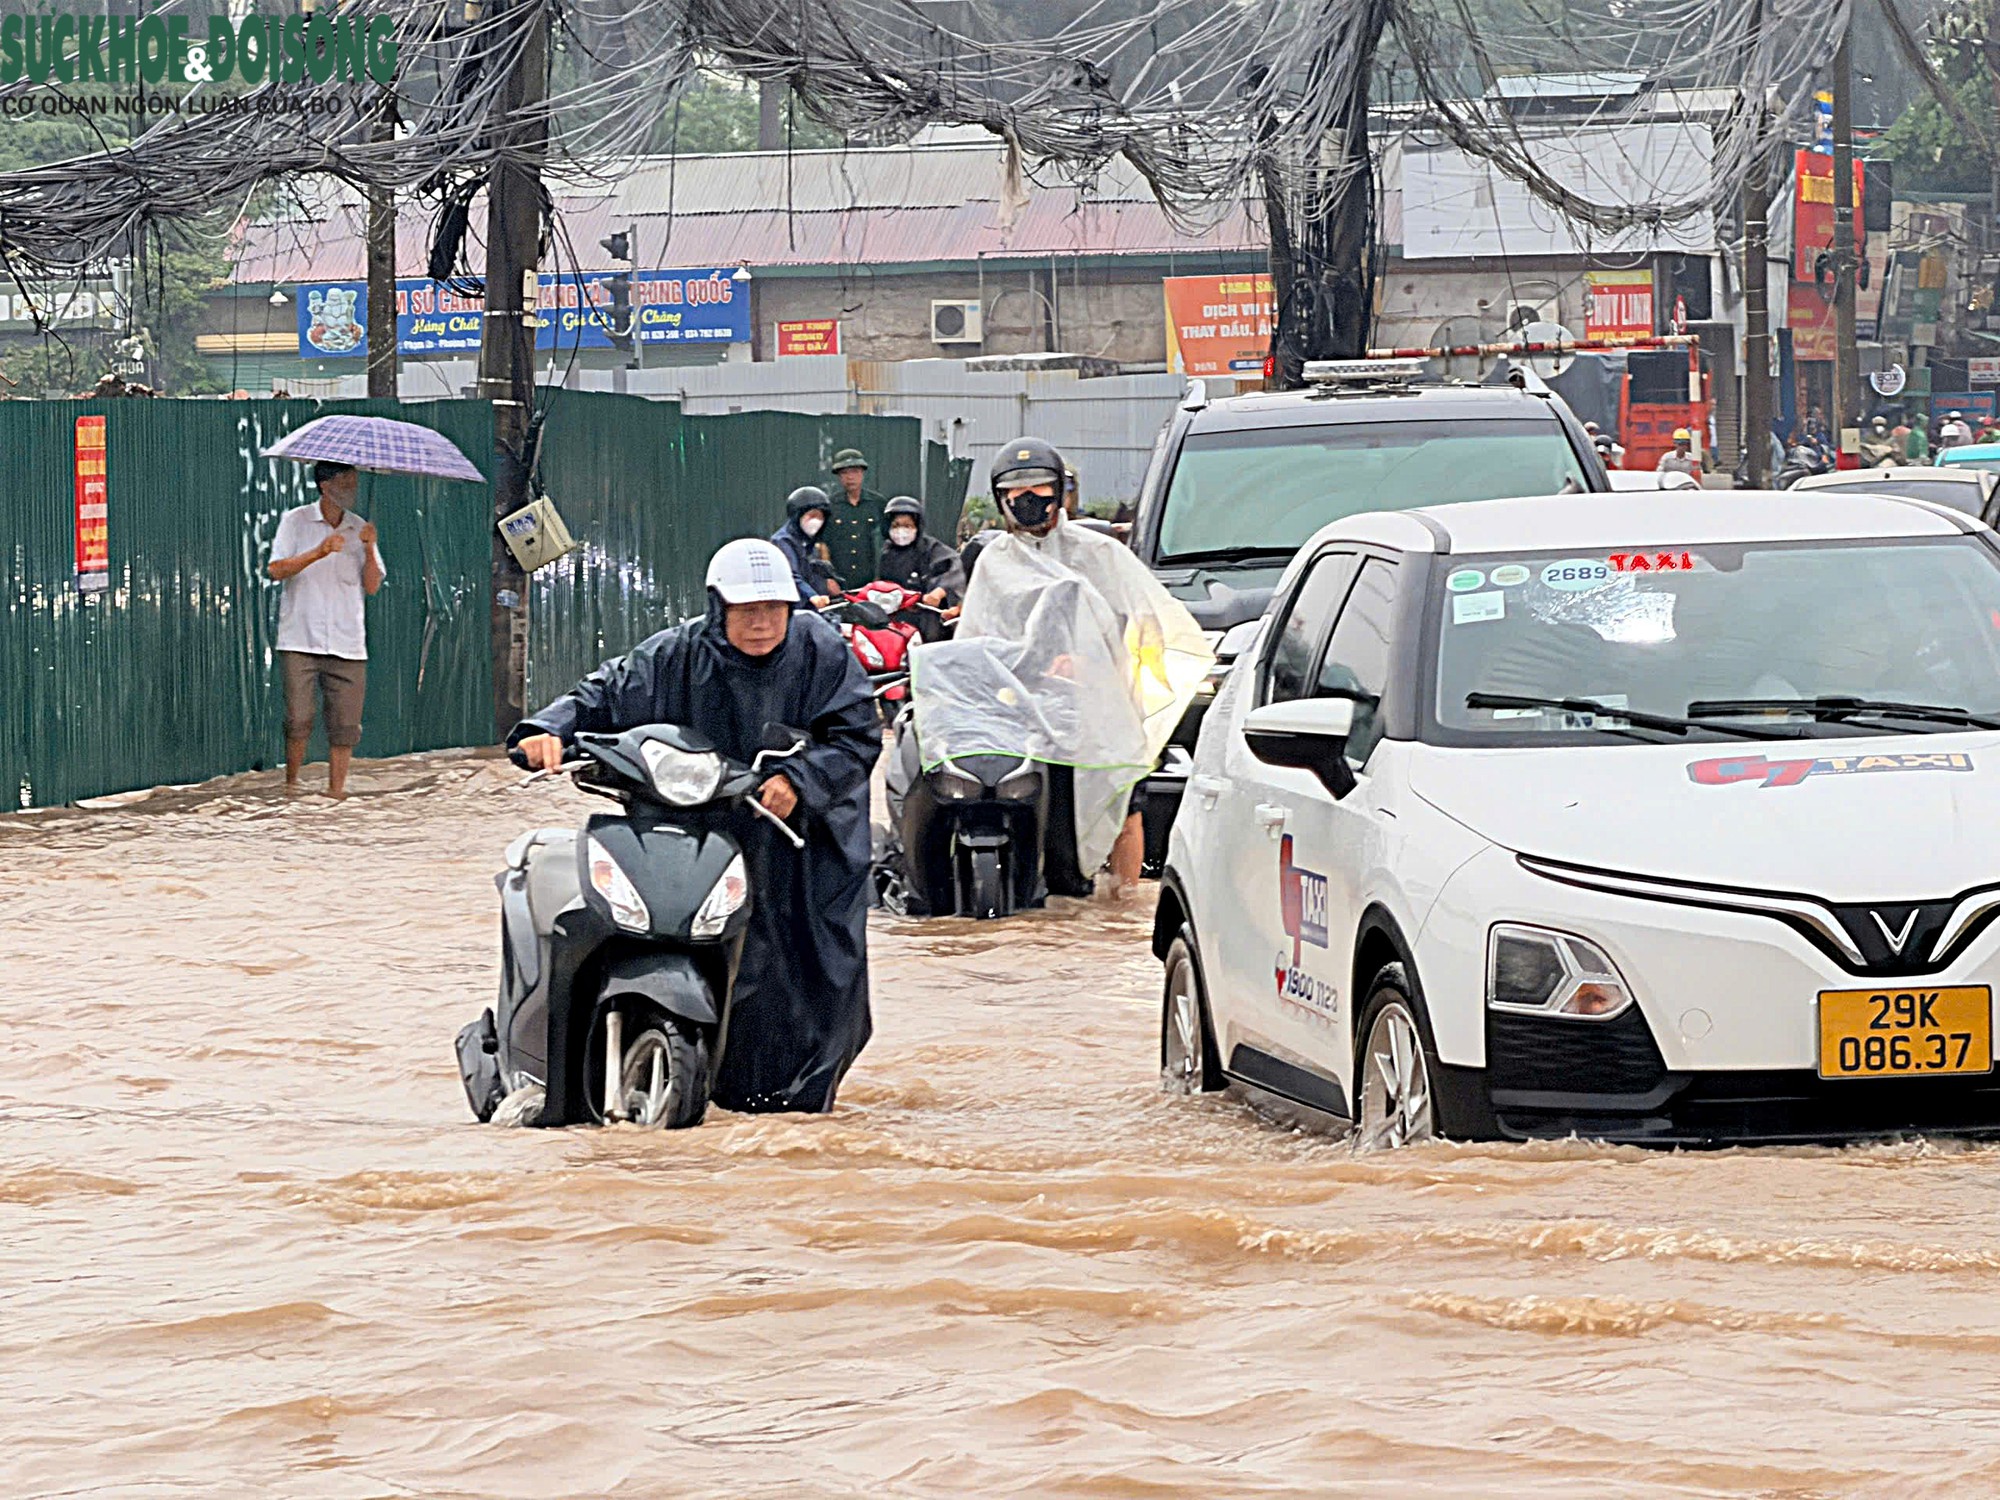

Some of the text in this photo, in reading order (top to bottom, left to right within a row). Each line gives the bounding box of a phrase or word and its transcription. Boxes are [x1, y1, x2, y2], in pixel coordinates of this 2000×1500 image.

[686, 271, 732, 306] QUỐC
[1203, 305, 1238, 320] DỊCH
[1181, 326, 1216, 338] THAY
[1547, 566, 1608, 583] 2689
[1610, 552, 1694, 572] TAXI
[1817, 754, 1971, 770] TAXI
[1301, 875, 1329, 929] TAXI
[1287, 968, 1314, 1001] 1900
[1869, 992, 1940, 1030] 29K
[1840, 1033, 1972, 1072] 086.37
